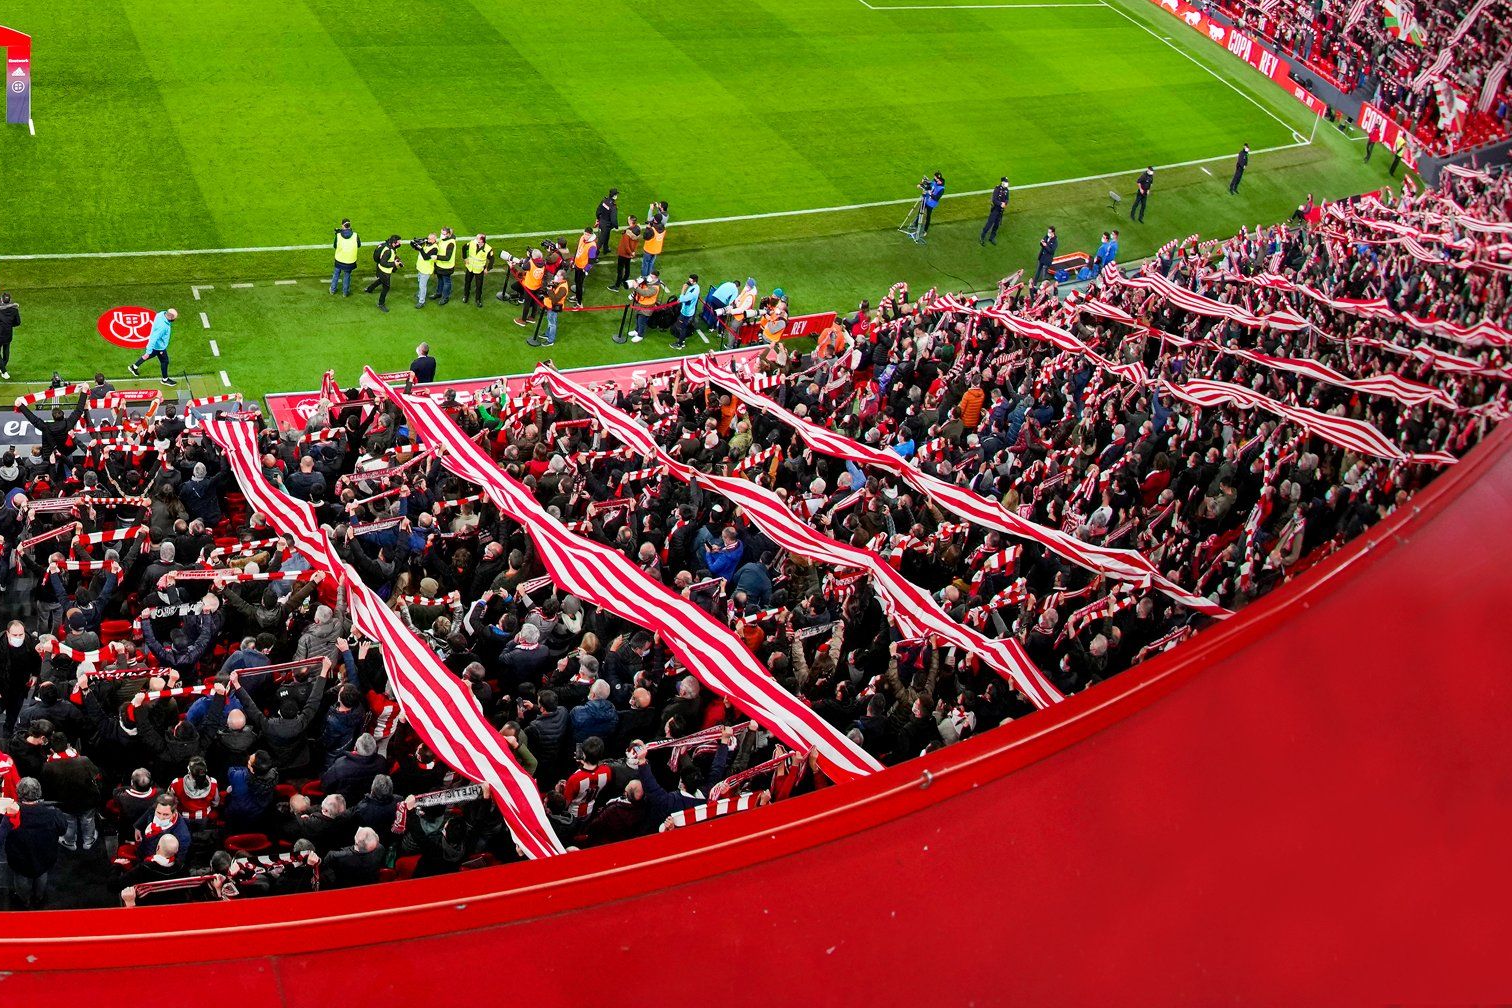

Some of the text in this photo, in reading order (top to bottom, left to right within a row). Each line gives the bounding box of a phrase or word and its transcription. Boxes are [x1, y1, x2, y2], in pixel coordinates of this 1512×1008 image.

[1227, 29, 1279, 79] COPA REY
[790, 320, 808, 336] REY
